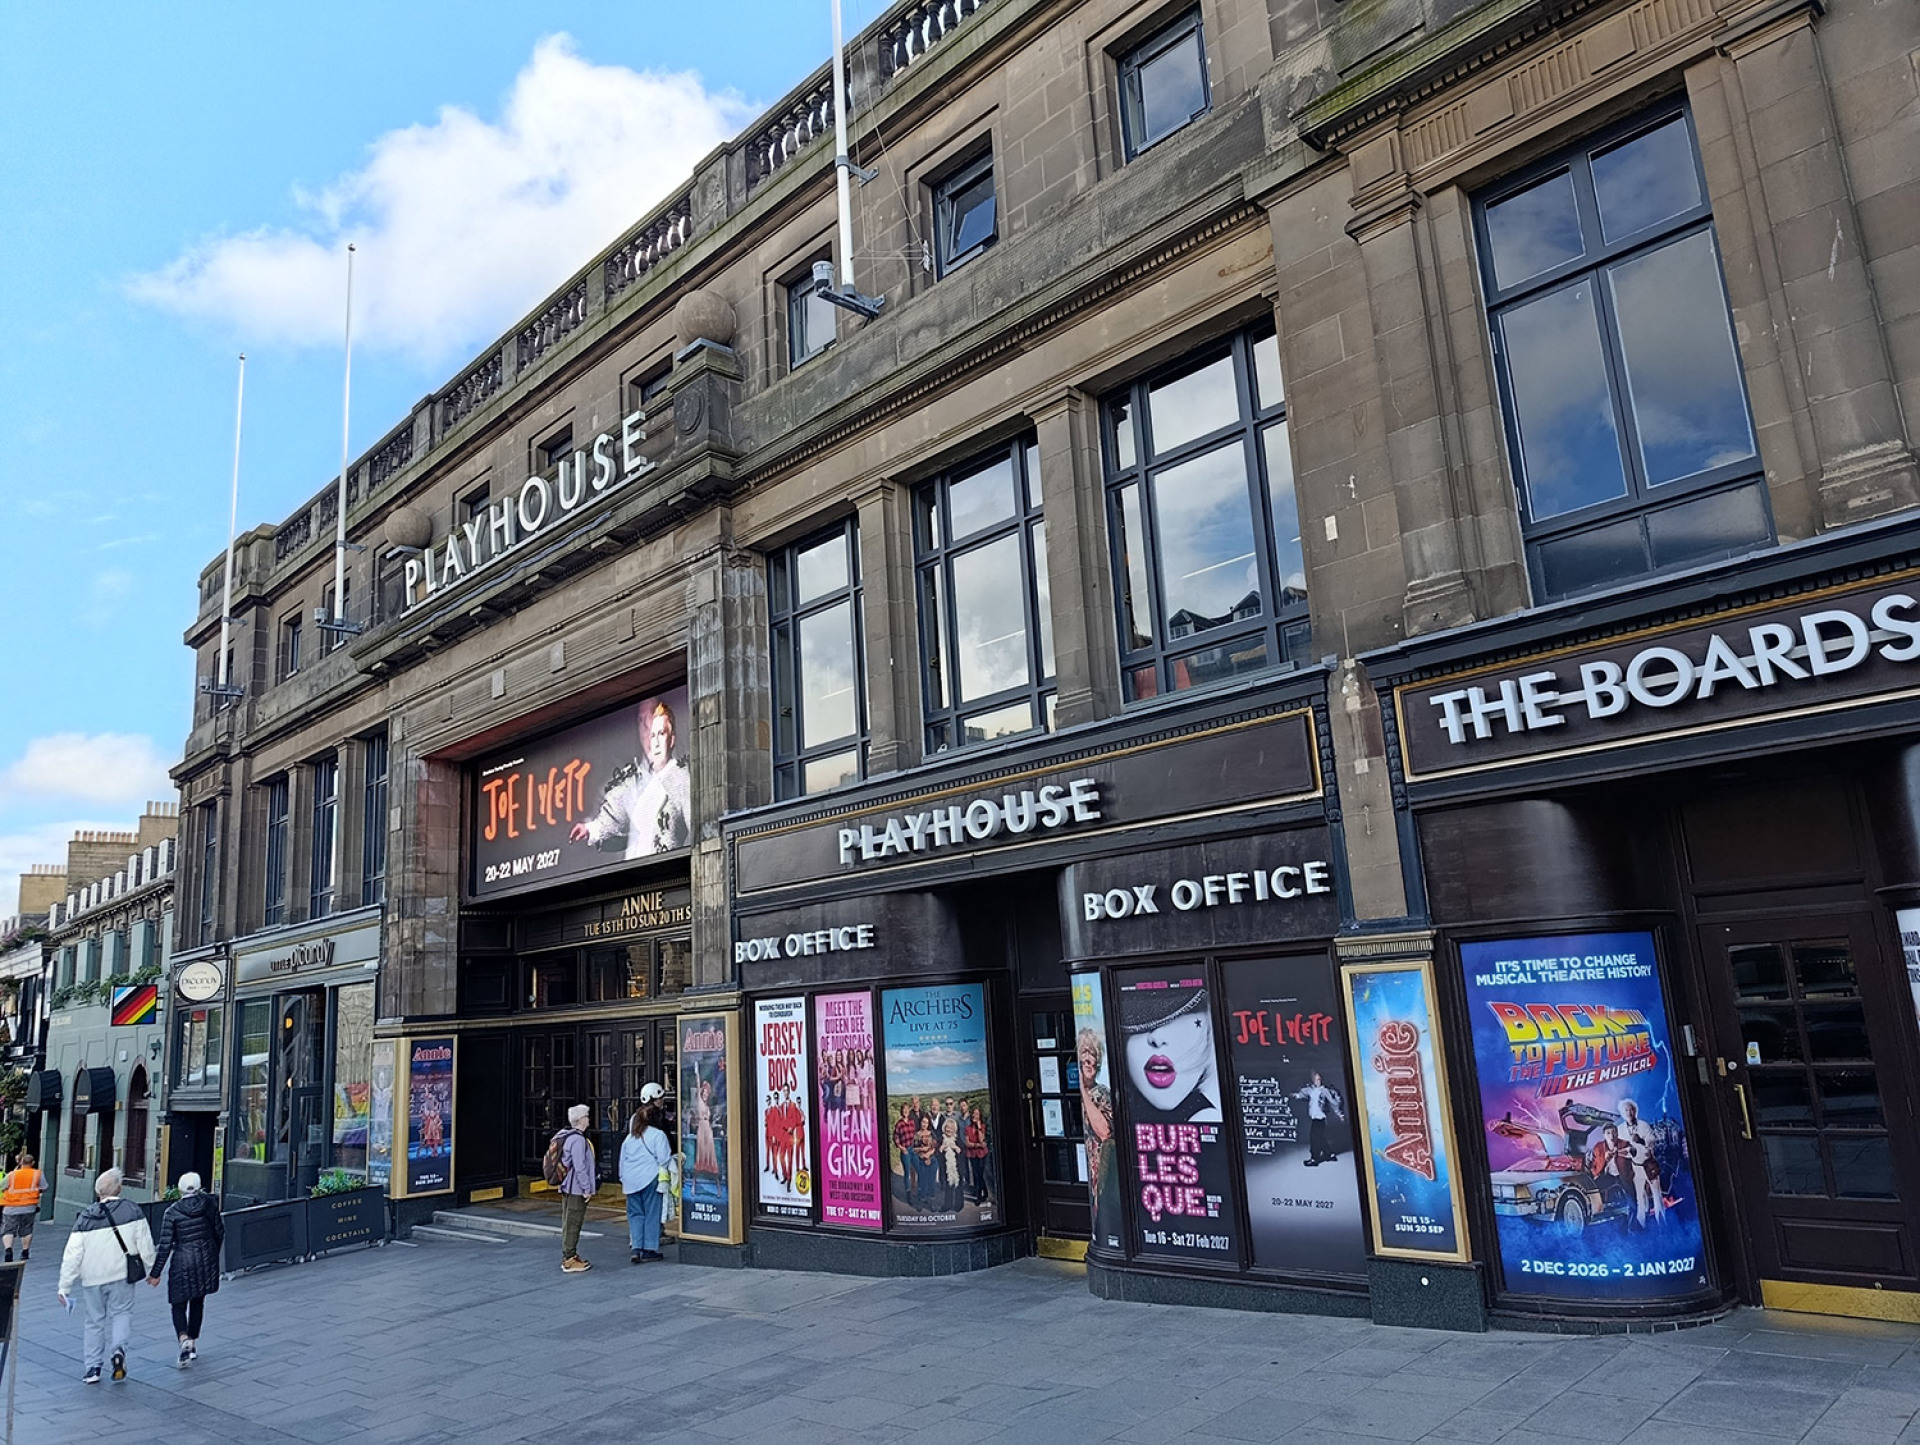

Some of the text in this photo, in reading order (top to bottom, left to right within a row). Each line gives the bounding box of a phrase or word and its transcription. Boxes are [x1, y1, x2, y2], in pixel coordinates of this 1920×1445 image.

[405, 410, 647, 606] PLAYHOUSE
[1429, 594, 1920, 745] THE BOARDS
[482, 758, 592, 841] JOE LYCETT
[839, 777, 1101, 865] PLAYHOUSE
[484, 848, 560, 883] 20-22 MAY 2027
[1084, 860, 1331, 921] BOX OFFICE
[621, 891, 663, 917] ANNIE
[584, 922, 600, 938] TUE
[625, 915, 638, 930] TO
[640, 913, 658, 928] SUN
[735, 923, 875, 964] BOX OFFICE
[1476, 964, 1652, 986] MUSICAL THEATRE HISTORY
[1495, 953, 1637, 973] IT'S TIME TO CHANGE
[825, 999, 863, 1017] MEET THE
[890, 993, 973, 1025] ARCHERS
[825, 1016, 865, 1034] QUEEN BEE
[909, 1020, 958, 1033] LIVE AT 75
[1232, 1010, 1334, 1047] JOE LYCETT
[1487, 1001, 1629, 1043] BACK
[683, 1026, 724, 1053] Annie
[760, 1021, 803, 1057] JERSEY
[820, 1035, 830, 1051] OF
[831, 1033, 873, 1051] MUSICALS
[412, 1045, 452, 1061] Annie
[1510, 1031, 1651, 1076] TO FUTURE
[768, 1057, 797, 1093] BOYS
[1509, 1062, 1542, 1082] THE
[1566, 1057, 1652, 1089] THE MUSICAL
[1373, 1021, 1436, 1181] Annie
[827, 1107, 872, 1143] MEAN
[1135, 1123, 1202, 1153] BUR
[827, 1142, 875, 1180] GIRLS
[1138, 1153, 1199, 1185] LES
[331, 1197, 363, 1210] COFFEE
[826, 1205, 837, 1217] TUE
[837, 1206, 845, 1217] 17
[848, 1207, 859, 1219] SAT
[860, 1208, 867, 1220] 21
[868, 1210, 881, 1221] NOV
[1141, 1183, 1207, 1223] QUE
[1271, 1197, 1335, 1209] 20-22 MAY 2027
[337, 1214, 358, 1224] WINE
[711, 1213, 722, 1223] SEP
[928, 1214, 956, 1222] OCTOBER
[1394, 1223, 1445, 1234] SUN 20 SEP
[1401, 1215, 1418, 1224] TUE
[325, 1227, 371, 1243] COCKTAILS
[1143, 1229, 1157, 1244] Tue
[1157, 1230, 1167, 1245] 16
[1172, 1232, 1186, 1247] Sat
[1186, 1233, 1195, 1248] 27
[1196, 1233, 1210, 1249] Feb
[1211, 1235, 1230, 1250] 2027
[1521, 1259, 1531, 1272] 2
[1534, 1260, 1565, 1275] DEC
[1567, 1262, 1609, 1277] 2026
[1623, 1263, 1634, 1277] 2
[1637, 1261, 1666, 1276] JAN
[1668, 1256, 1696, 1273] 2027
